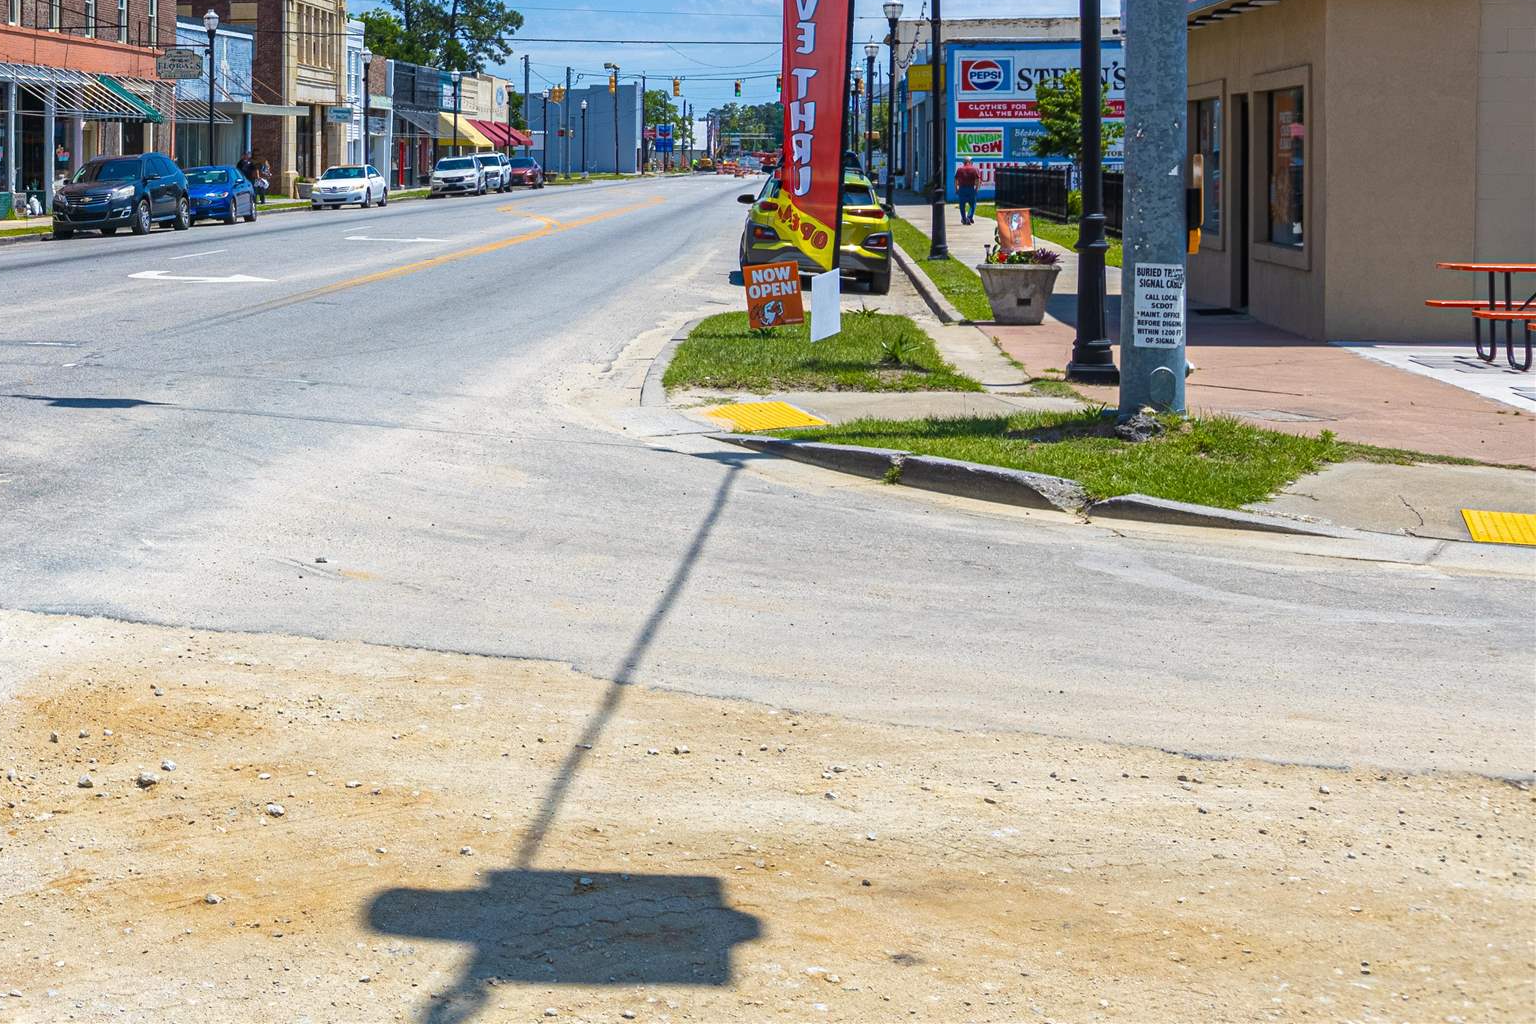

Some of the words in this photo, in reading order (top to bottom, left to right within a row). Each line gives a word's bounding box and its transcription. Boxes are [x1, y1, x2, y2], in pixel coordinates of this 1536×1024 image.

[969, 70, 1002, 80] PEPSI
[968, 103, 1008, 111] CLOTHES
[1011, 103, 1027, 111] FOR
[1014, 110, 1041, 118] FAMIL
[751, 266, 791, 284] NOW
[1136, 267, 1162, 277] BURIED
[1139, 279, 1165, 289] SIGNAL
[748, 280, 798, 299] OPEN!
[1145, 293, 1160, 301] CALL
[1160, 294, 1178, 302] LOCAL
[1137, 319, 1161, 327] BEFORE
[1137, 328, 1159, 336] WITHIN
[1155, 337, 1176, 345] SIGNAL
